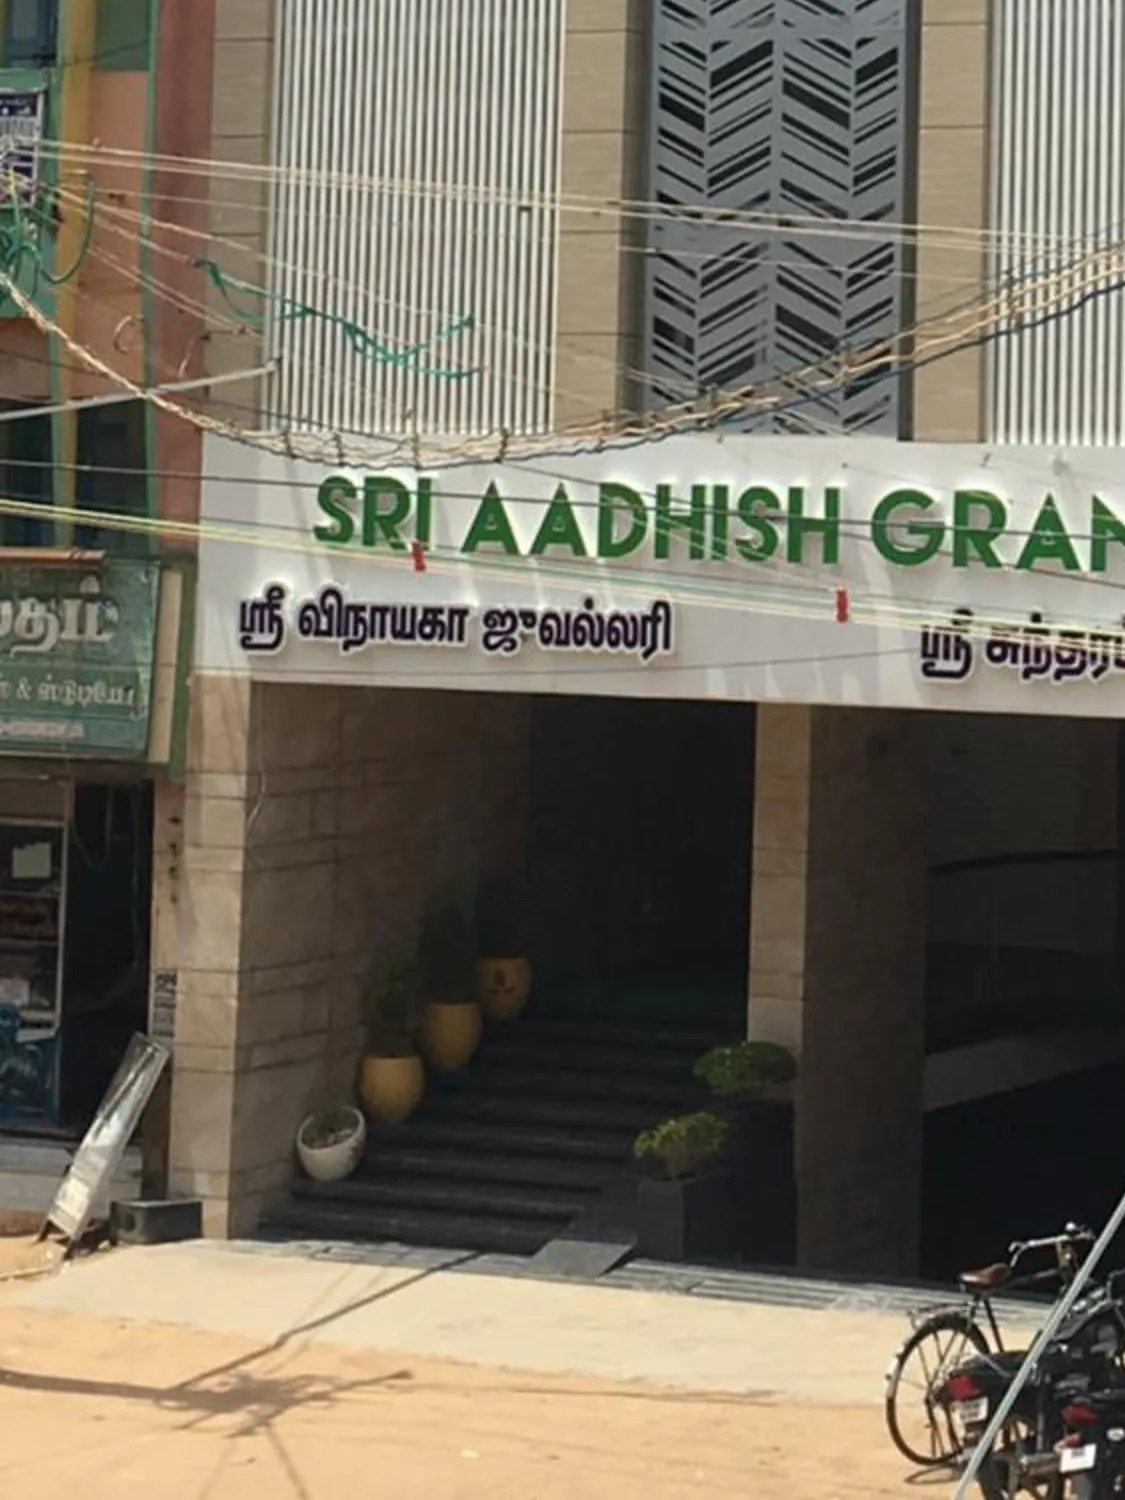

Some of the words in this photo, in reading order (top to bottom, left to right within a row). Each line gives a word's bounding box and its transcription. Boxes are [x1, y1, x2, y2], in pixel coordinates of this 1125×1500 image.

[314, 476, 432, 550] SRI
[461, 480, 840, 564] AADHISH
[298, 587, 469, 650] விநாயகா
